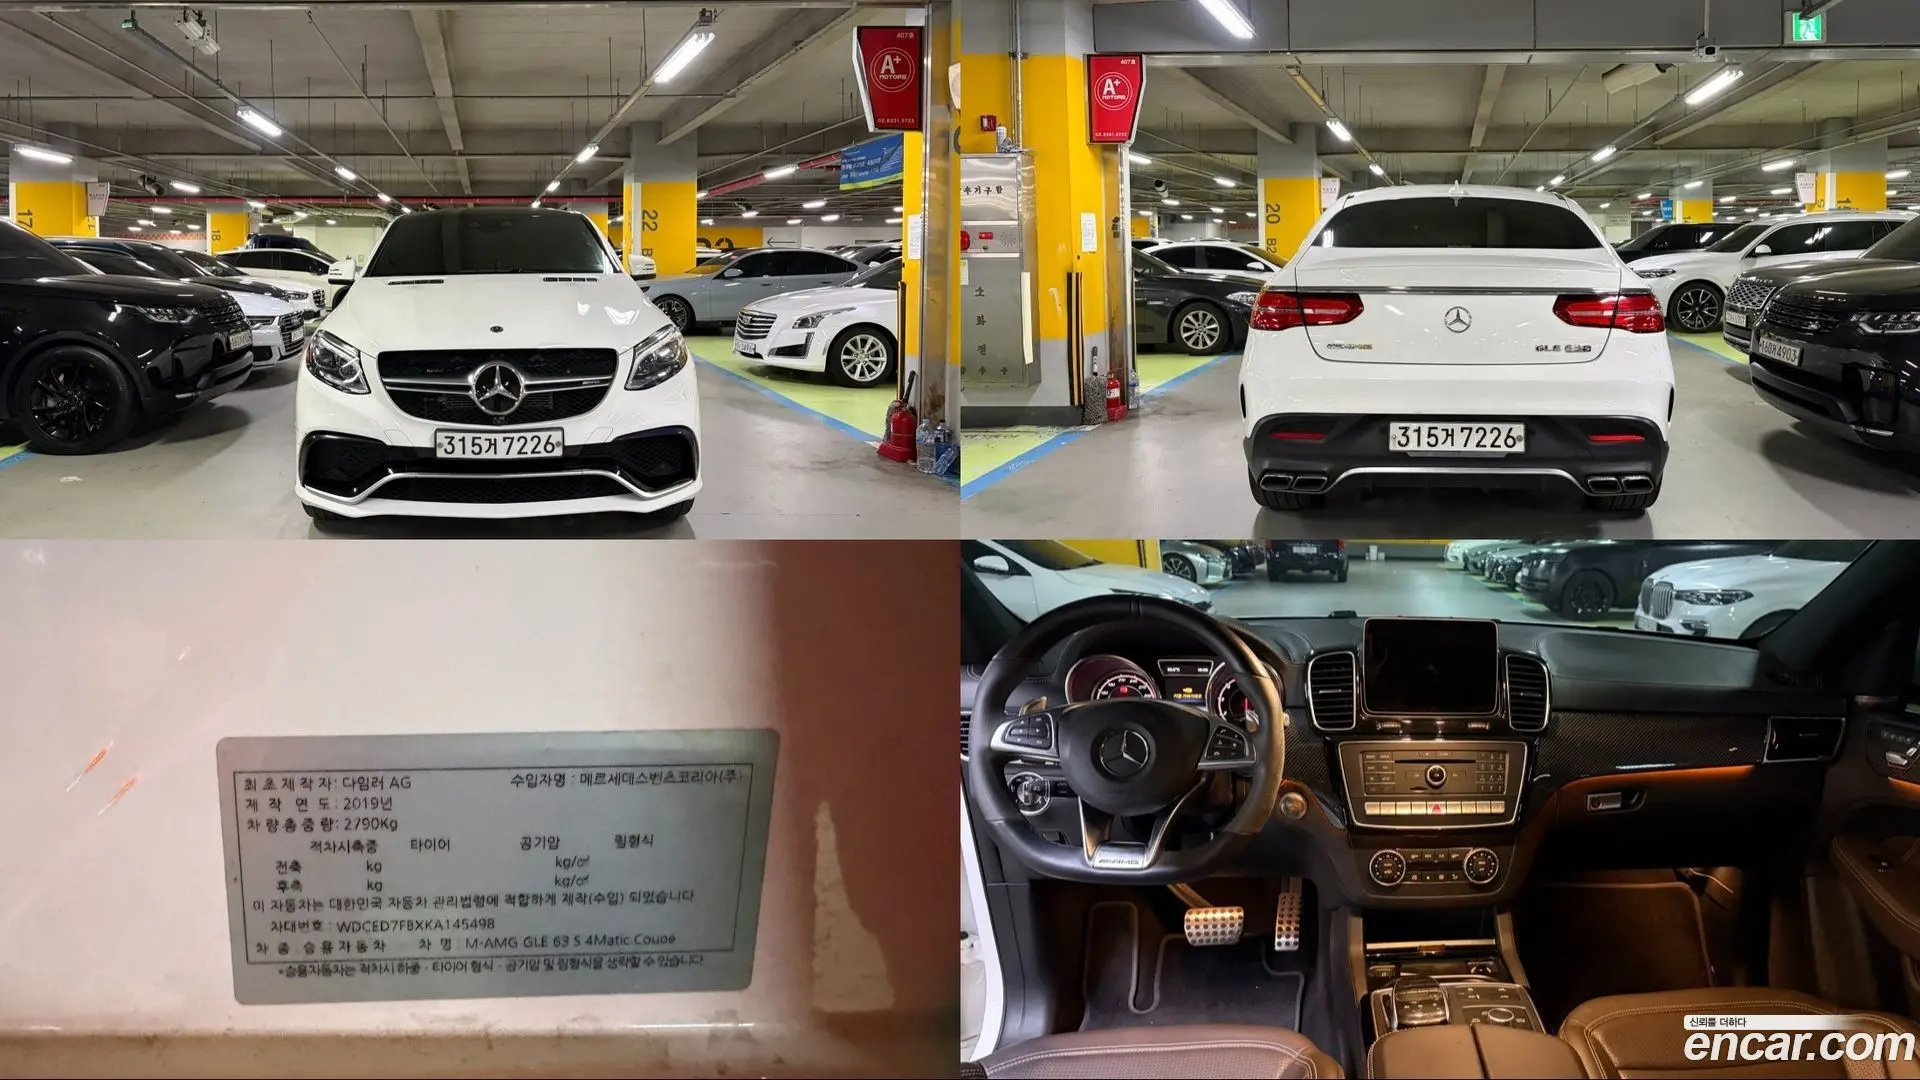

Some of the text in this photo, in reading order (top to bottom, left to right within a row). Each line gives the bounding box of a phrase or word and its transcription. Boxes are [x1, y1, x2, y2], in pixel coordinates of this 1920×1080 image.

[960, 184, 1003, 196] 수기구함
[17, 209, 33, 229] 17
[642, 210, 658, 231] 22
[1266, 203, 1281, 225] 20
[1267, 238, 1277, 254] B2
[343, 776, 384, 791] 다임러
[389, 776, 412, 789] AG
[343, 796, 393, 811] 2019년
[344, 817, 398, 832] 2790Kg
[409, 838, 451, 852] 타이어
[519, 835, 561, 850] 공기압
[366, 860, 382, 874] kg
[366, 879, 383, 893] kg
[253, 900, 265, 912] 이
[270, 898, 324, 913] 자동차는
[329, 897, 382, 911] 대한민국
[523, 936, 548, 948] GLE
[553, 935, 570, 948] 63
[574, 935, 581, 947] S
[585, 934, 629, 946] 4Matic
